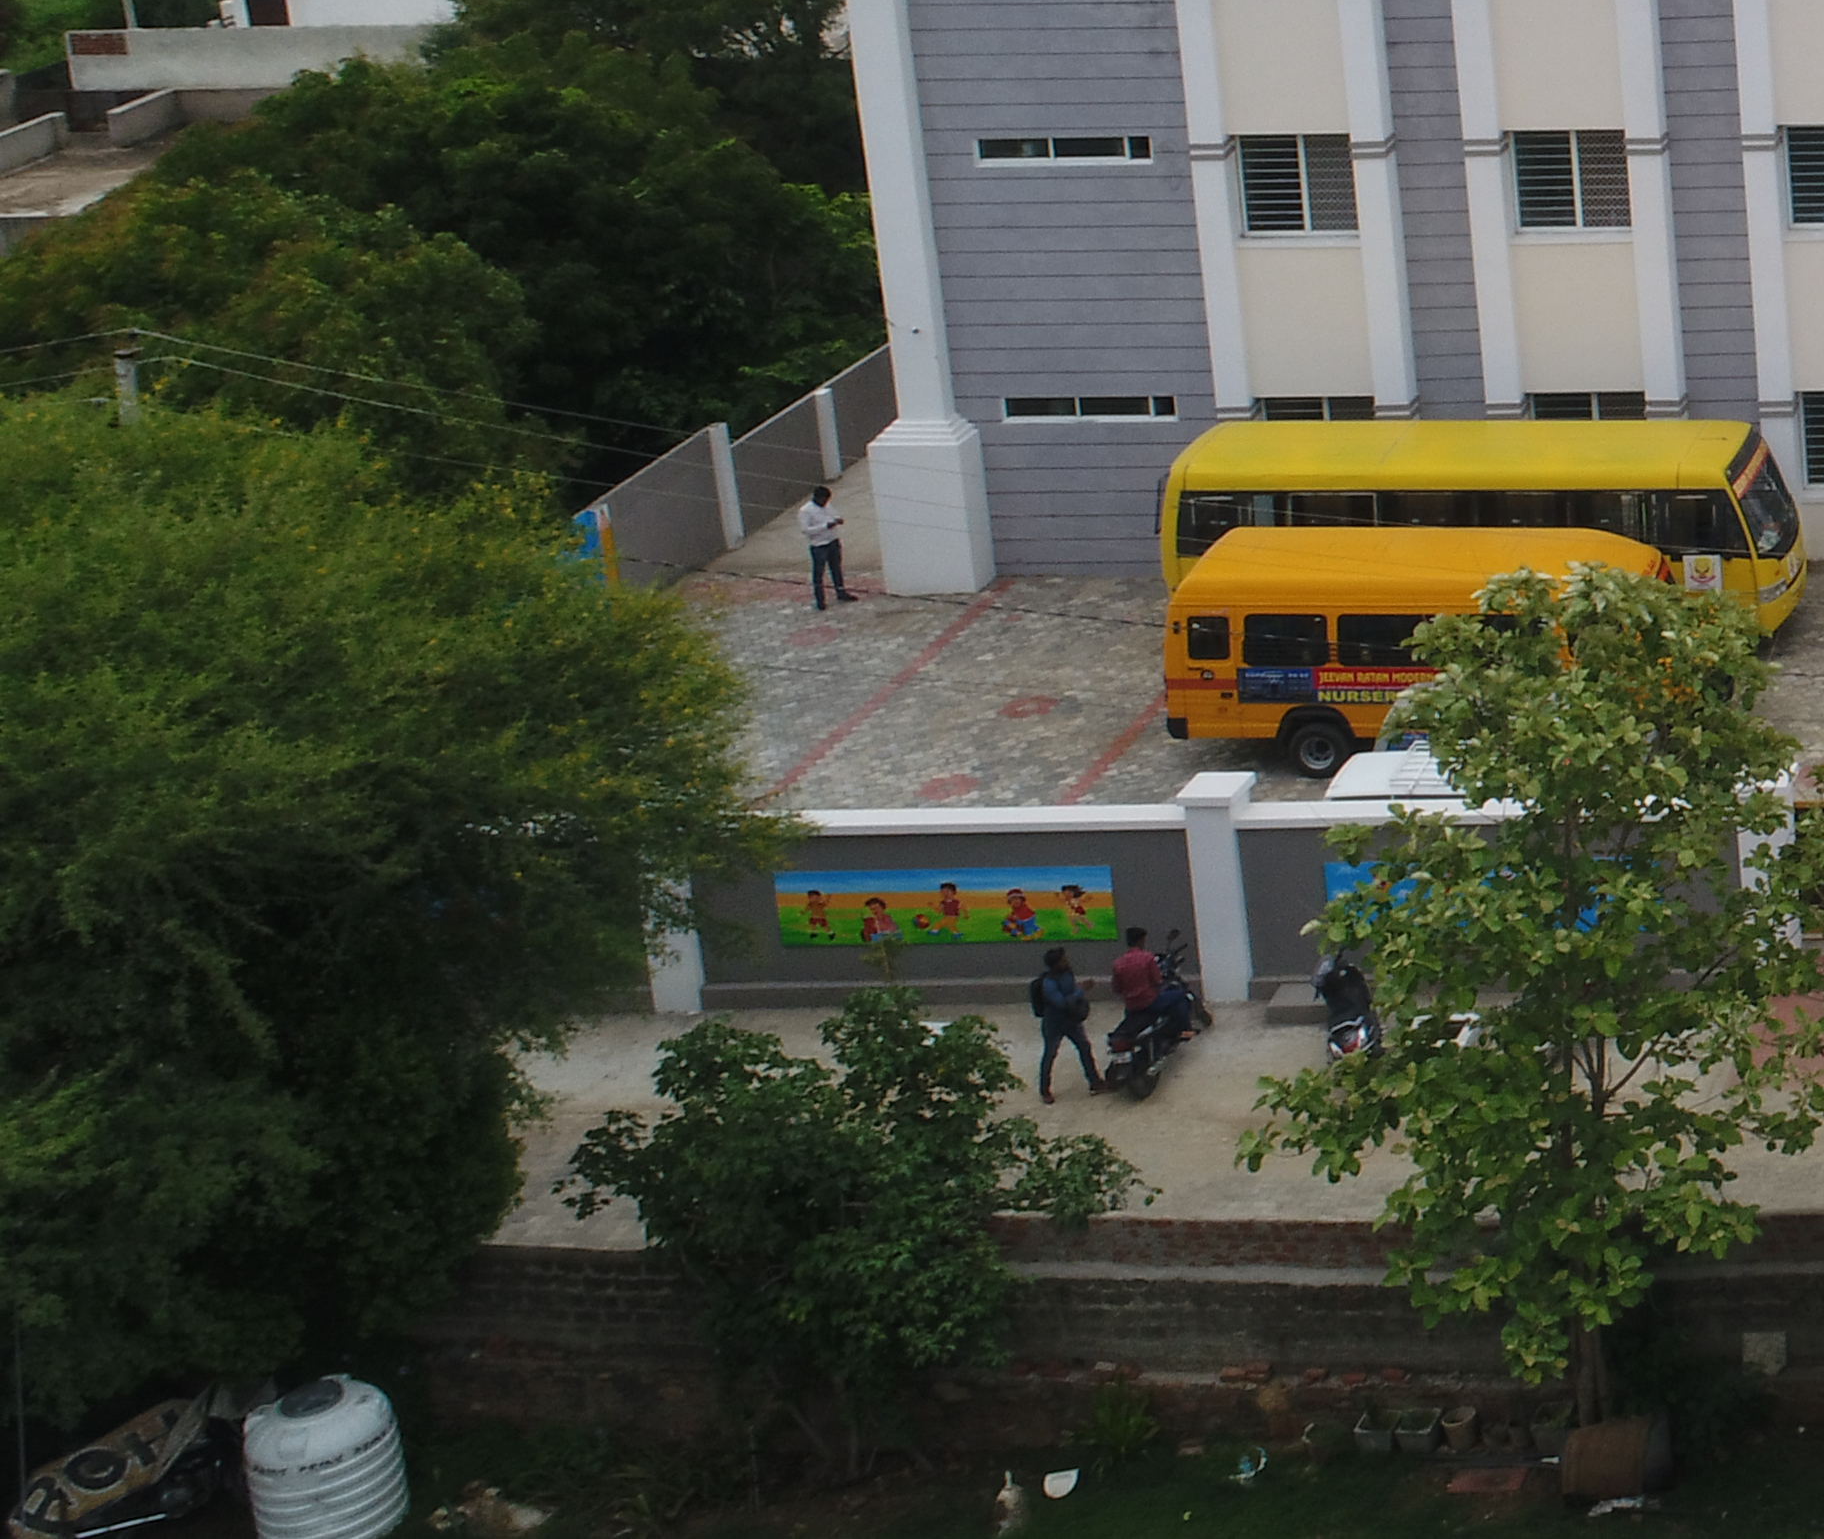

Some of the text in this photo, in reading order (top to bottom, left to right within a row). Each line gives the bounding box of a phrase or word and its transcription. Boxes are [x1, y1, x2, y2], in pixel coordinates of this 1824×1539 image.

[1318, 672, 1355, 684] JEEVAN
[1356, 672, 1390, 683] RATAN
[1317, 690, 1398, 703] NURSER
